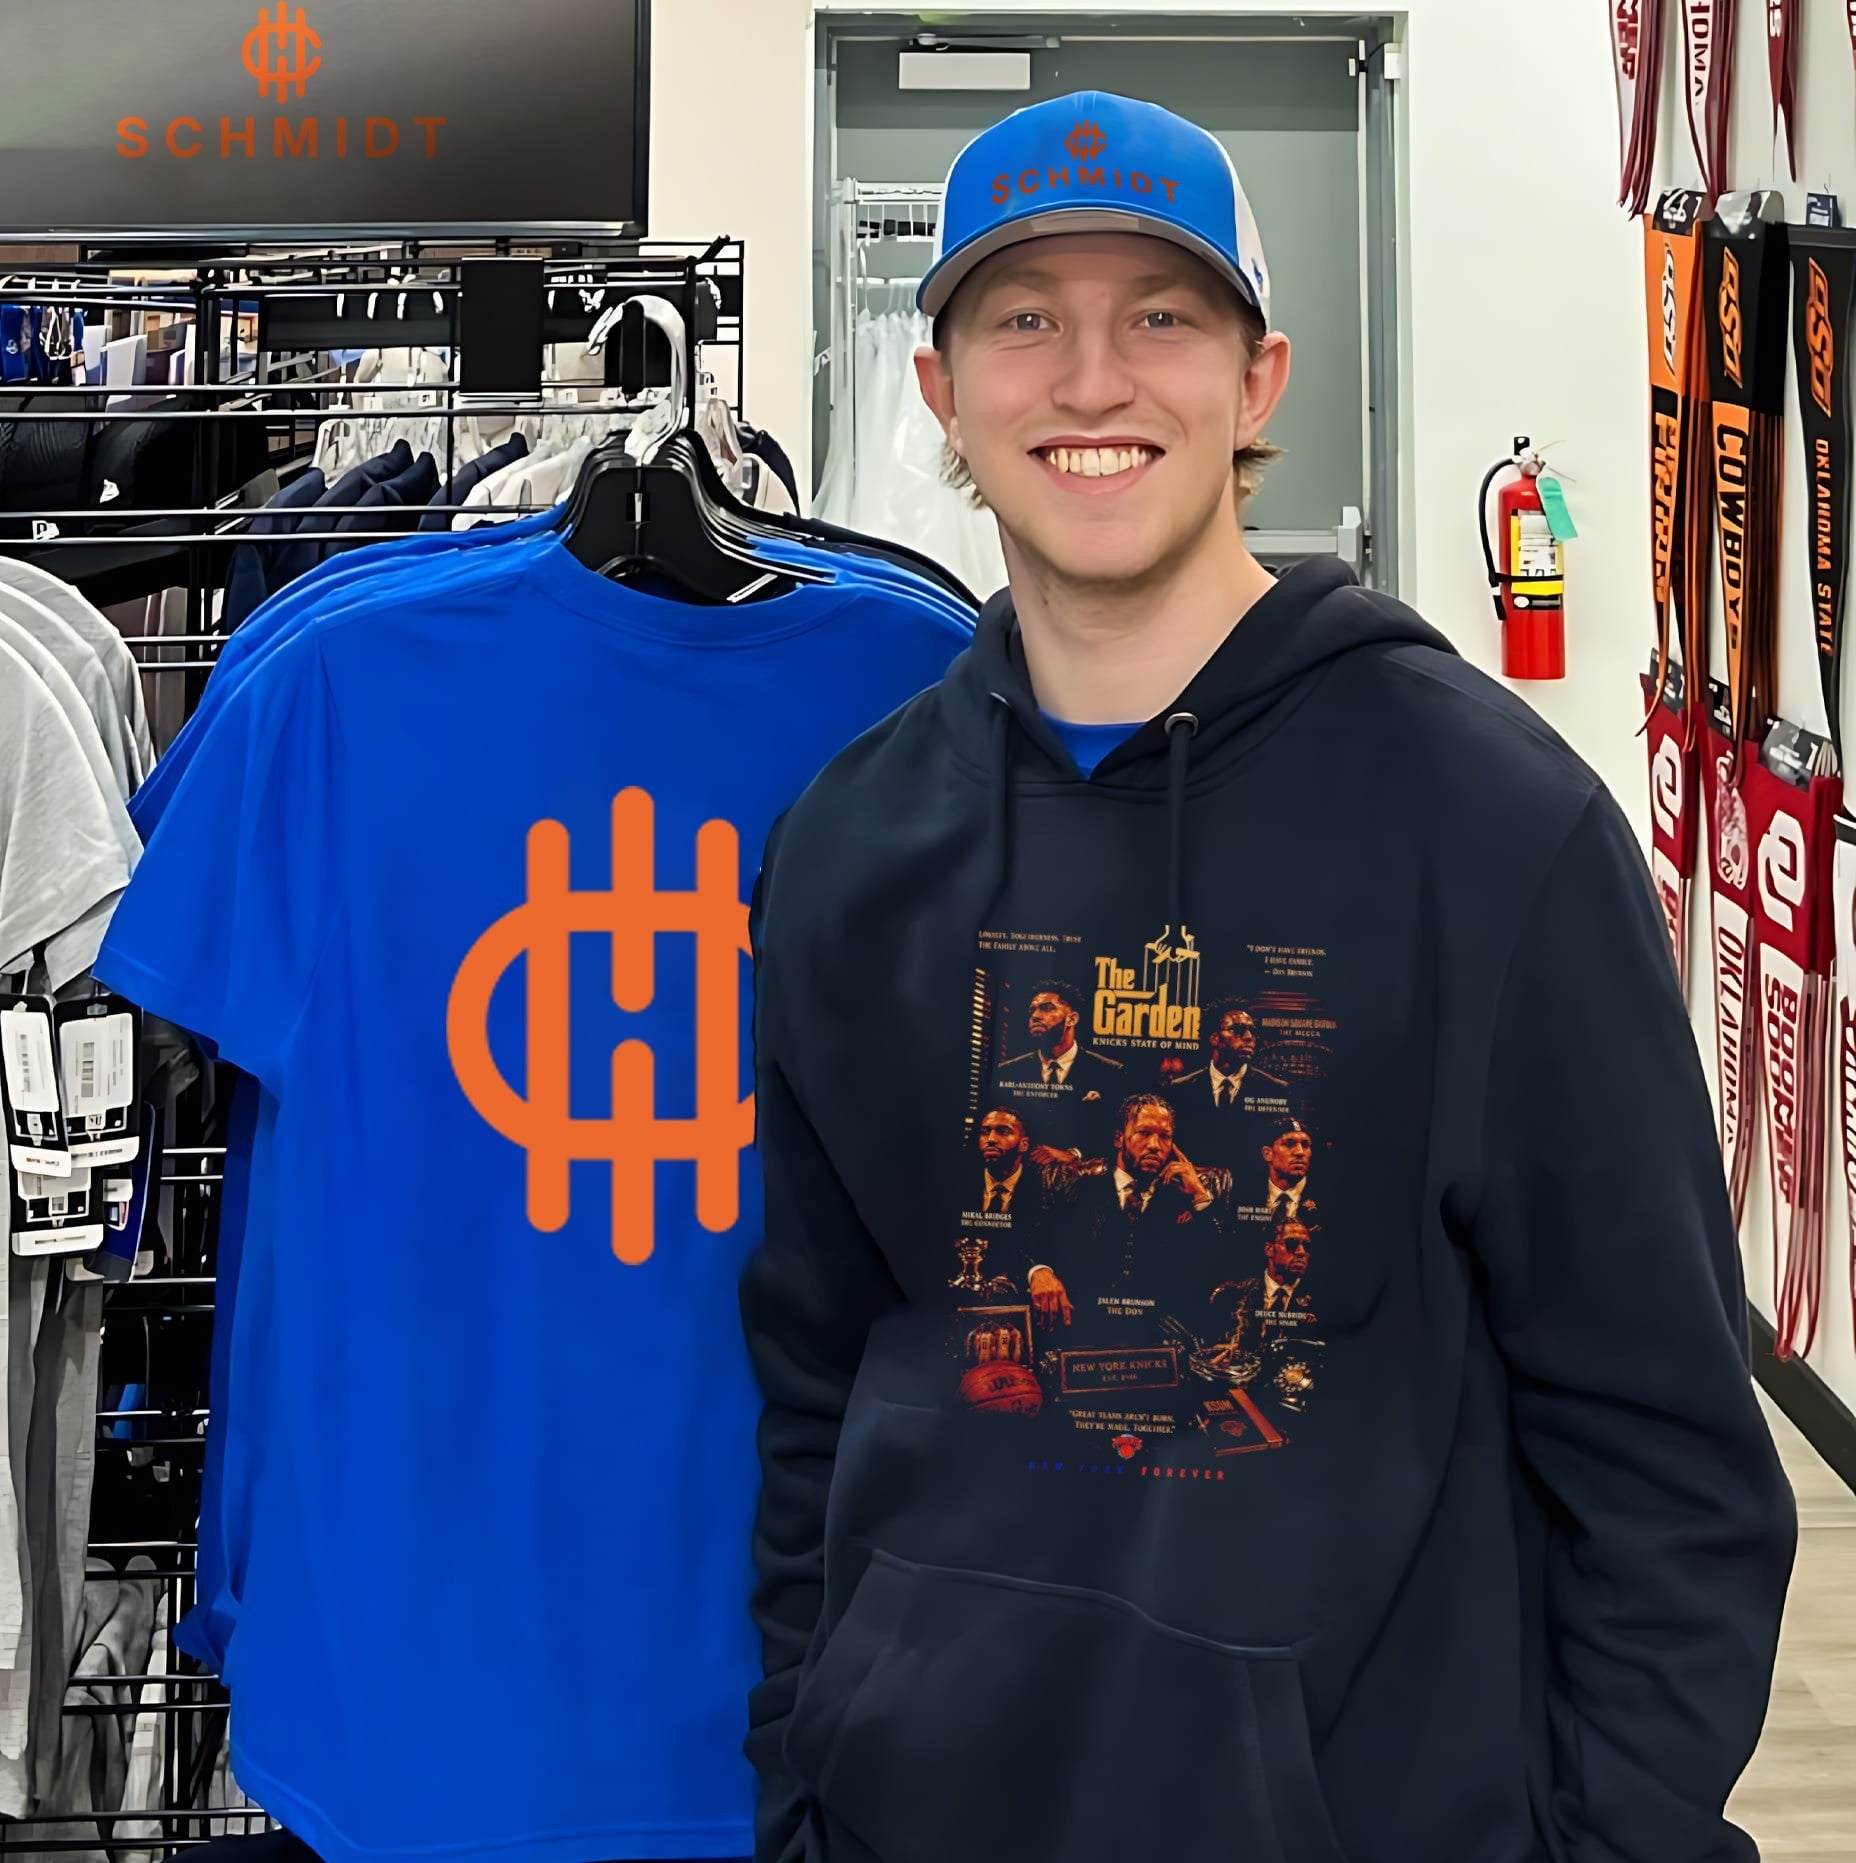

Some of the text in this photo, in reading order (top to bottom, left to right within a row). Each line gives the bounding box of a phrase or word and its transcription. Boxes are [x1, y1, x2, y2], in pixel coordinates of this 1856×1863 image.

[116, 116, 447, 159] SCHMIDT
[991, 167, 1179, 204] SCHMIDT
[1815, 438, 1833, 656] OKLAHOMA STATE
[1095, 957, 1135, 990] The
[1093, 983, 1201, 1040] Garden
[1093, 1037, 1199, 1051] KNICKS STATE OF MIND
[1097, 1297, 1156, 1307] JALEN BRUNSON
[1107, 1306, 1144, 1316] THE DON
[1072, 1359, 1167, 1373] NEW YORK KNICKS
[1140, 1465, 1225, 1480] FOREVER
